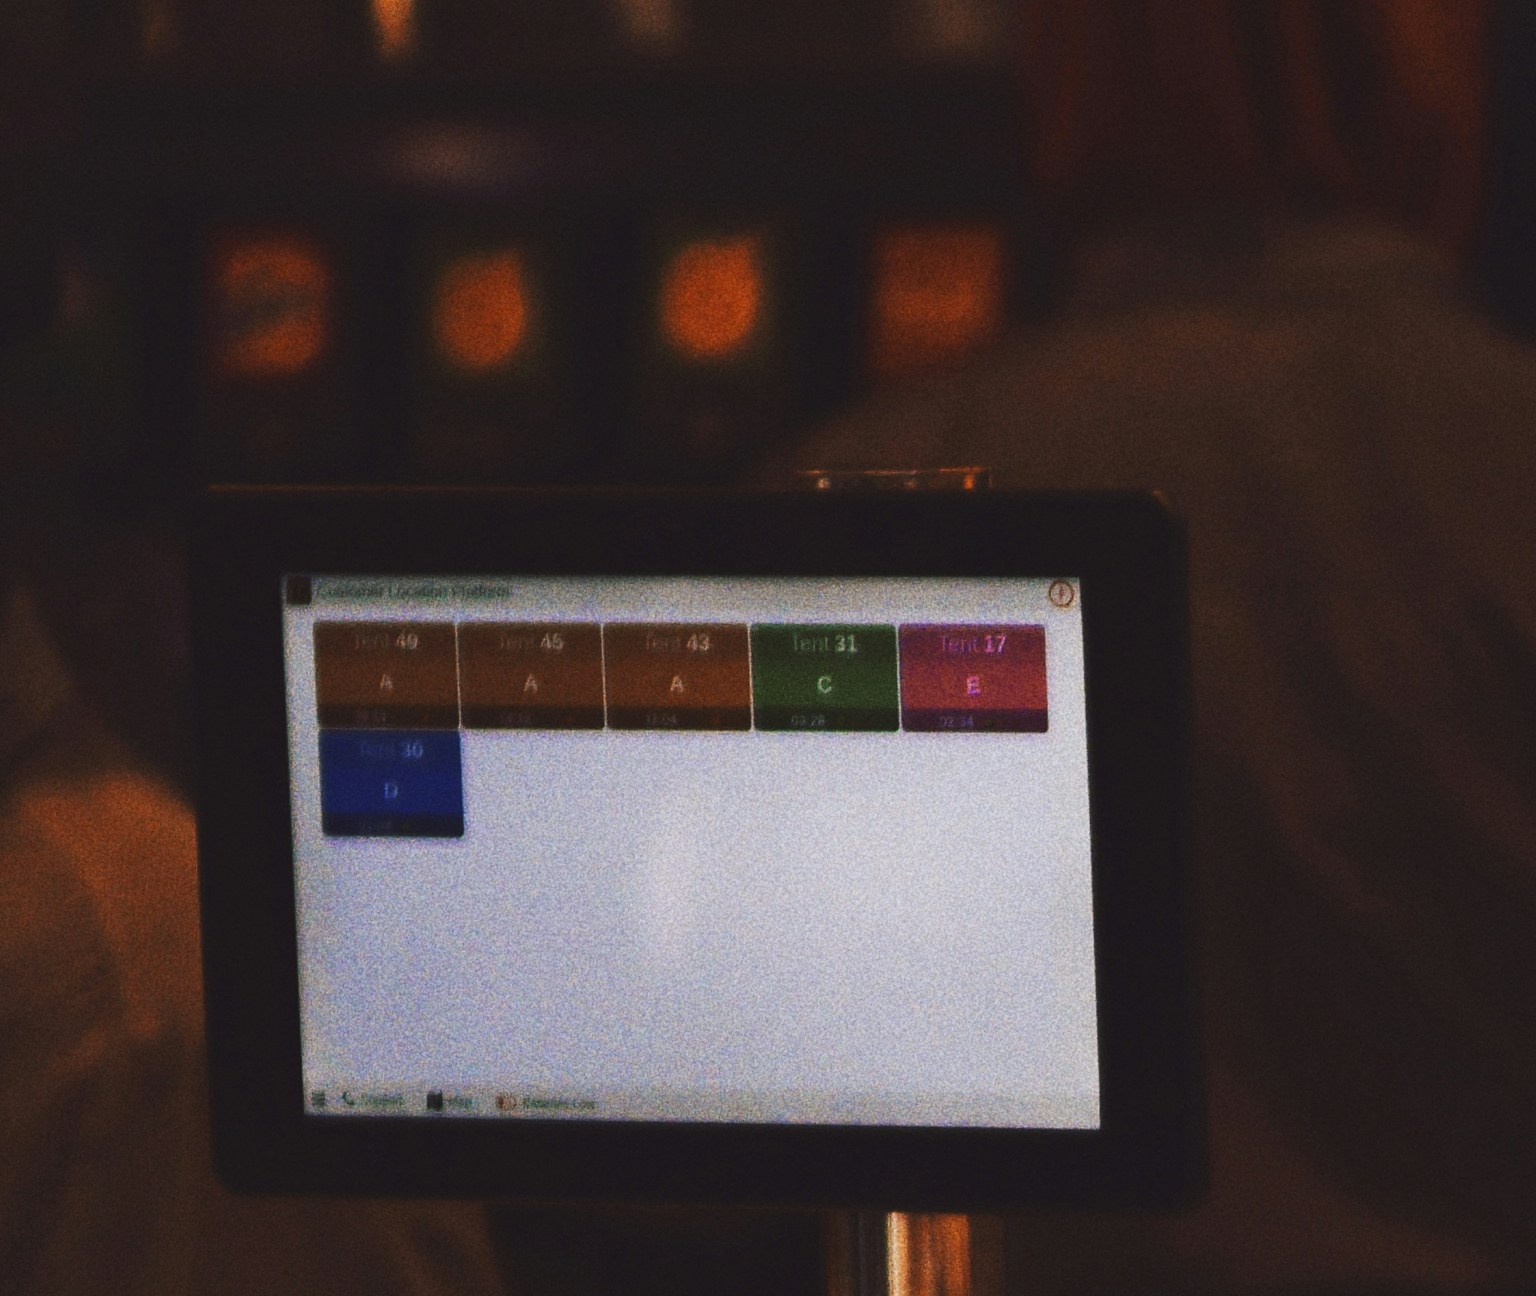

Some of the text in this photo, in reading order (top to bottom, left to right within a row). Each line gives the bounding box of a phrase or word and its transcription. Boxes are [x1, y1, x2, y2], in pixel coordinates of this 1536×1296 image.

[834, 634, 858, 652] 31
[983, 635, 1008, 652] 17
[378, 674, 394, 692] A
[523, 675, 539, 693] A
[669, 676, 685, 693] A
[816, 676, 833, 694] C
[965, 677, 981, 696] E
